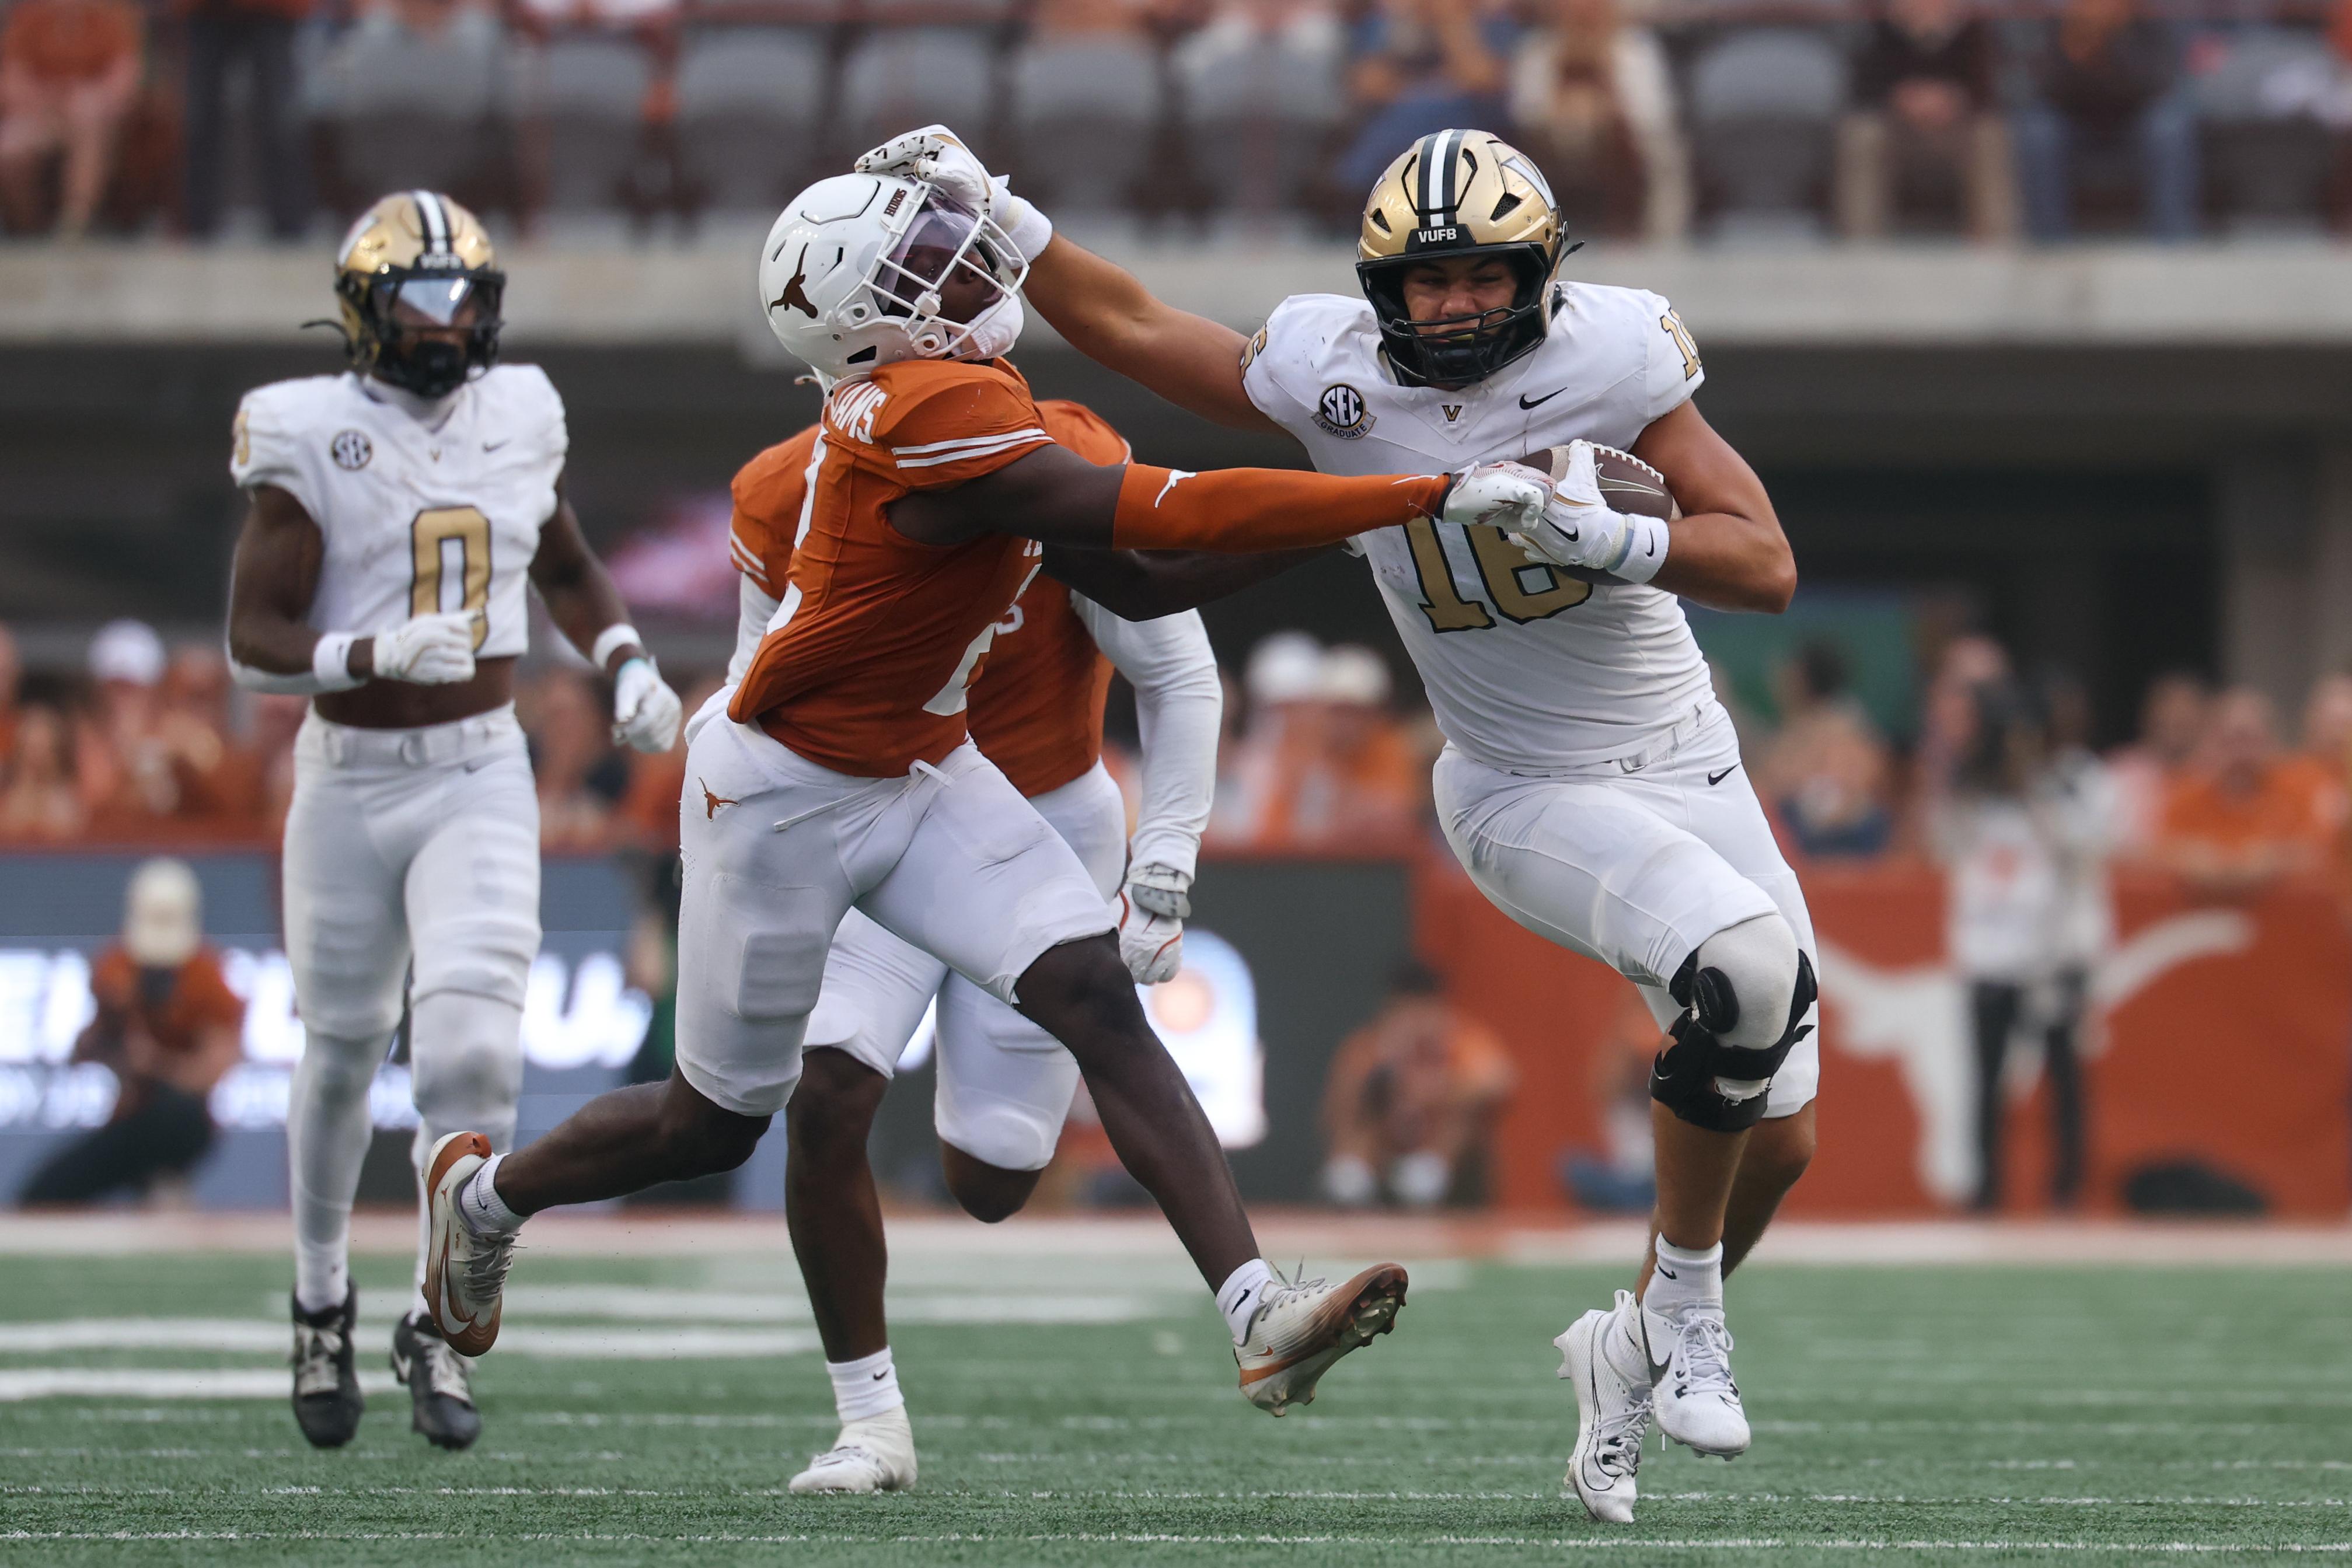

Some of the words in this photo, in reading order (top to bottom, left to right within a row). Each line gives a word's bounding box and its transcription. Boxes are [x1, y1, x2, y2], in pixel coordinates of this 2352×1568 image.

[1418, 228, 1457, 243] VUFB
[1322, 386, 1361, 426] SEC
[1441, 405, 1463, 422] V
[1320, 421, 1367, 438] GRADUATE
[334, 433, 371, 467] SEC
[410, 505, 492, 656] 0
[1401, 515, 1593, 634] 16
